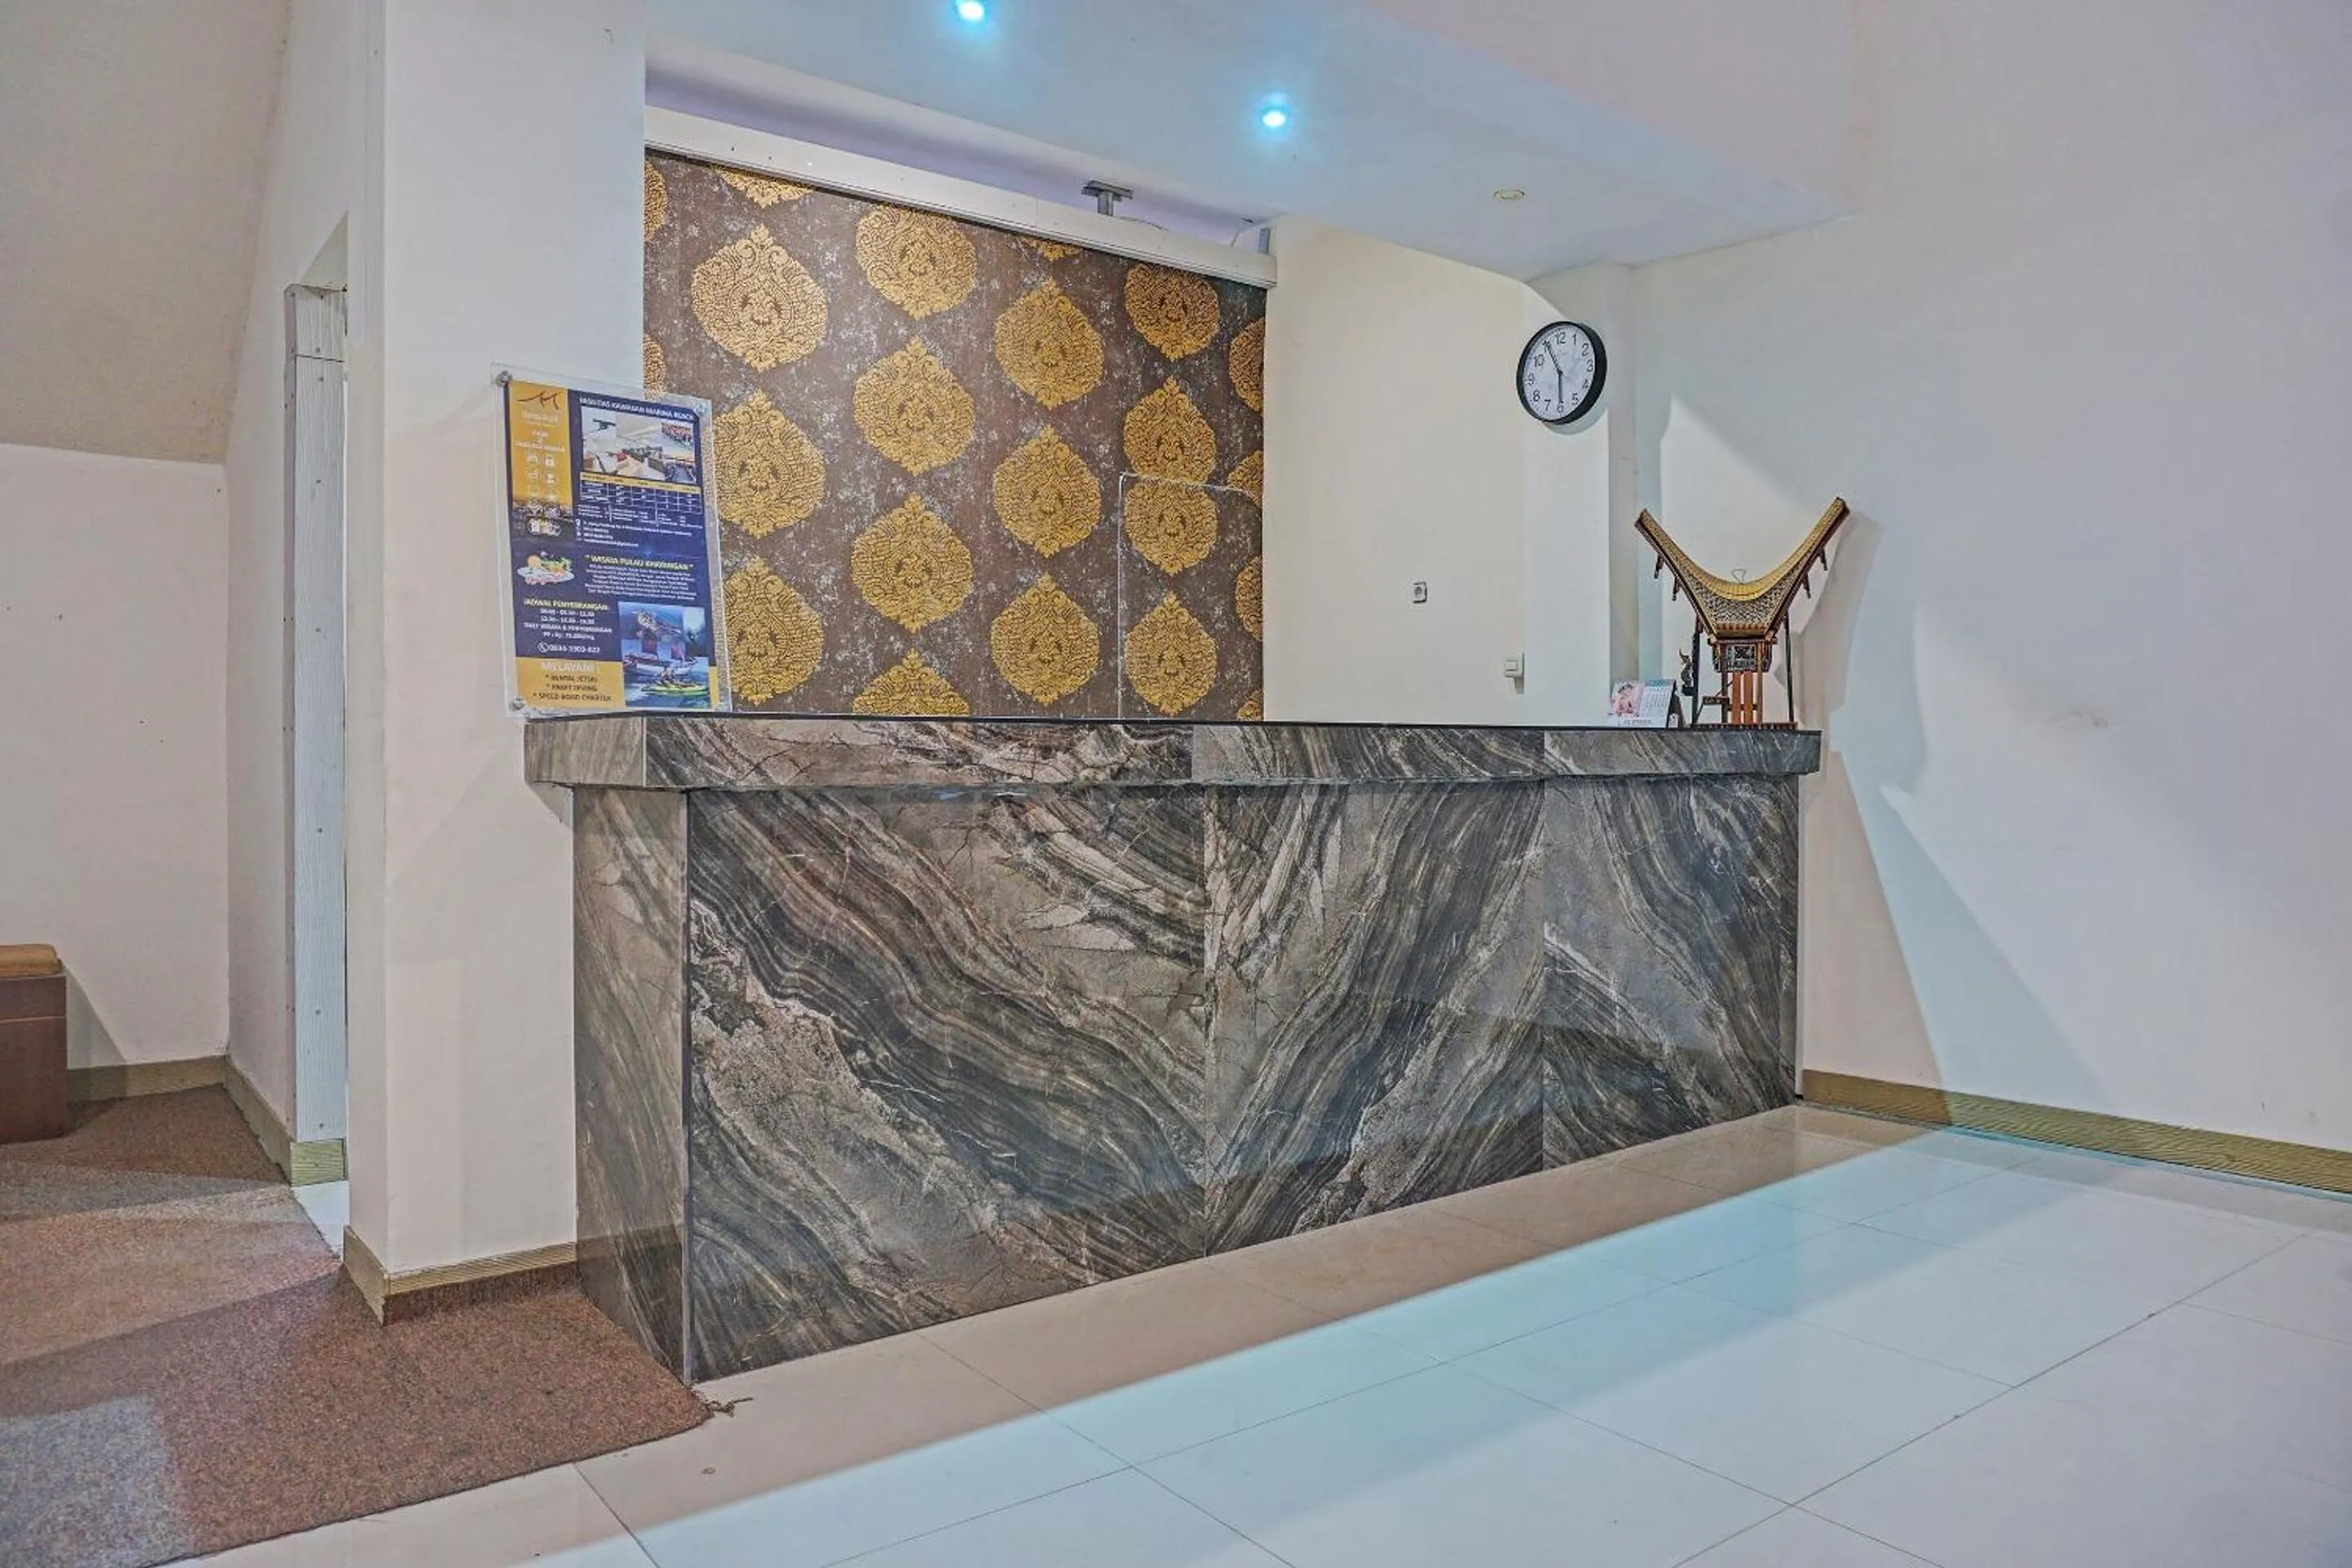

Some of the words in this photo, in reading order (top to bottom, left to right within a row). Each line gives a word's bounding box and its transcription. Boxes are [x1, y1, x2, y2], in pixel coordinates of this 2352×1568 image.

[1555, 332, 1566, 345] 12
[1572, 333, 1577, 345] 1
[1582, 343, 1589, 357] 2
[1534, 354, 1544, 367] 10
[1587, 359, 1593, 372] 3
[1526, 373, 1535, 386] 9
[1582, 379, 1588, 389] 4
[1533, 390, 1540, 402] 8
[1571, 393, 1579, 405] 5
[1544, 399, 1551, 411] 7
[1557, 401, 1564, 413] 6
